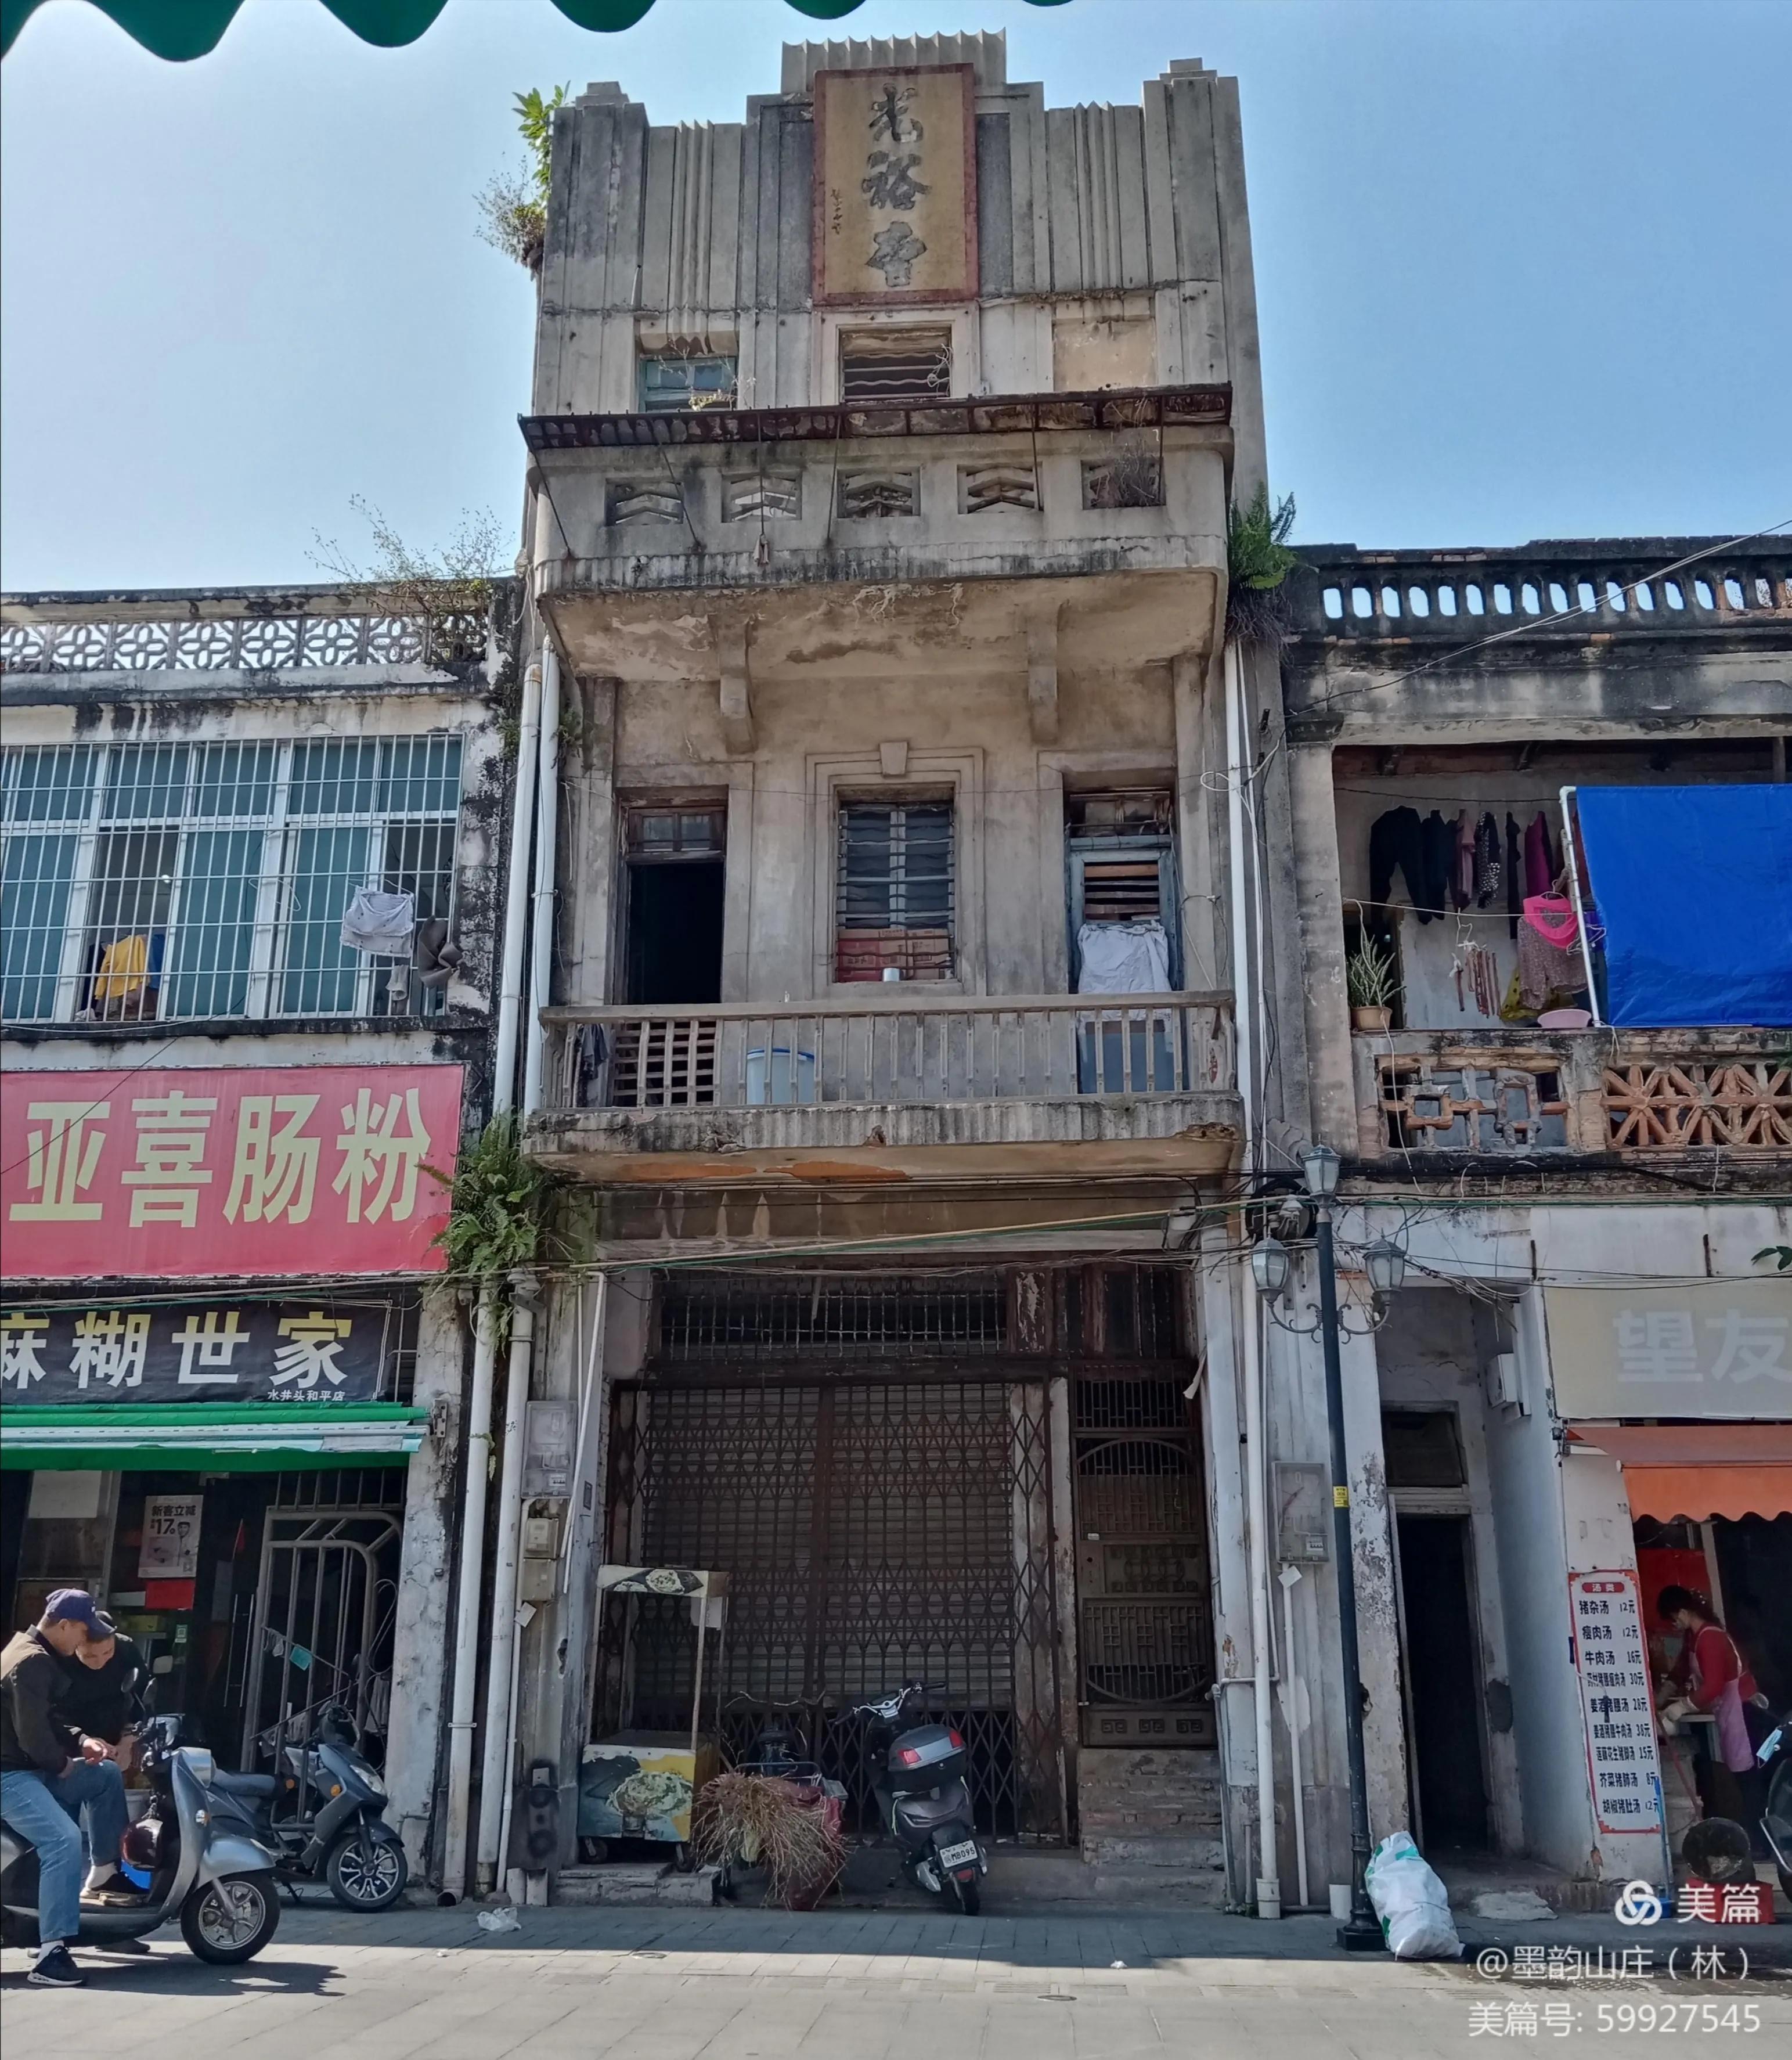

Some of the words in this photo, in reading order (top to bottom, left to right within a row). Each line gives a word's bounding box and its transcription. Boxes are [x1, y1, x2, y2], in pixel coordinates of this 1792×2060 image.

[9, 1087, 431, 1228] 亚喜肠粉
[0, 1310, 352, 1389] 麻糊世家
[267, 1389, 345, 1402] 水井头和平店
[1579, 1600, 1609, 1615] 猪杂汤
[1620, 1600, 1635, 1614] 12元
[1582, 1625, 1612, 1640] 瘦肉汤
[1623, 1625, 1638, 1639] 12元
[1585, 1651, 1615, 1665] 牛肉汤
